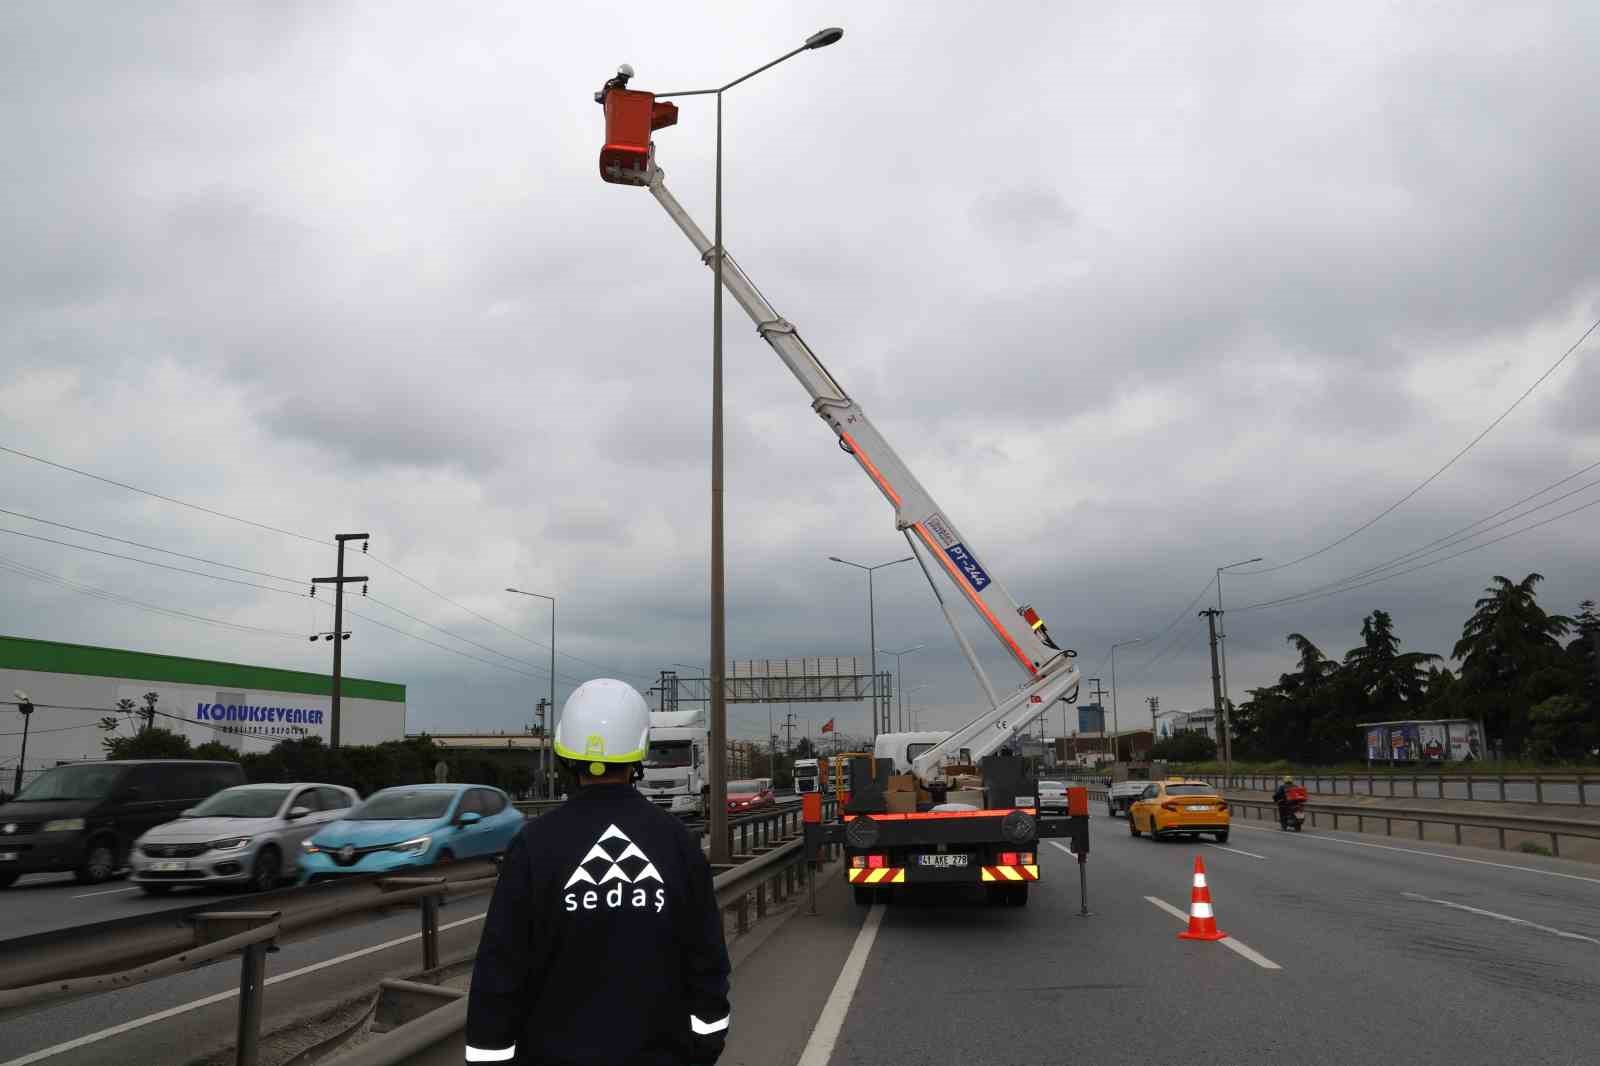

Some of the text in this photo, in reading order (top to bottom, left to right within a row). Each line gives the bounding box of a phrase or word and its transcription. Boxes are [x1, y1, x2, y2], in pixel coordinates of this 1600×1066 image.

[951, 547, 986, 585] PT-244
[196, 703, 323, 725] KONUKSEVENLER
[922, 855, 931, 865] 41
[564, 882, 665, 913] sedaş
